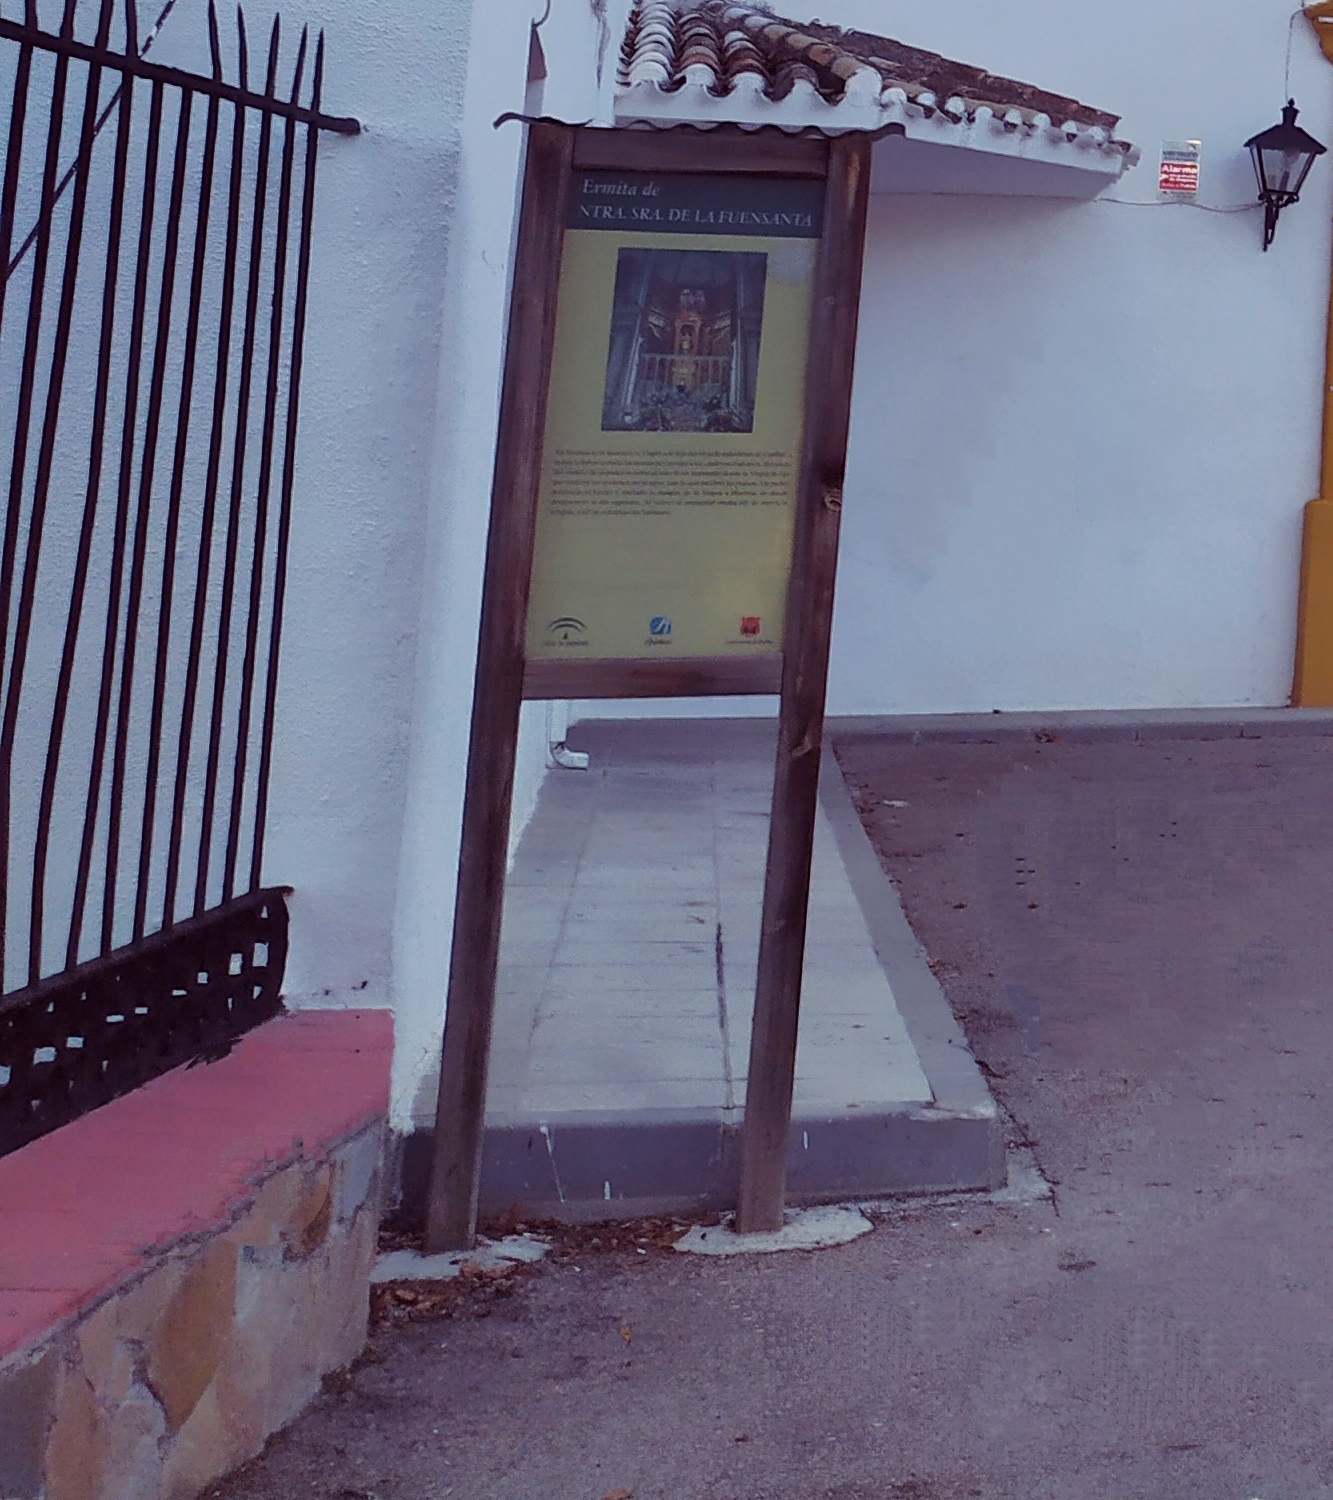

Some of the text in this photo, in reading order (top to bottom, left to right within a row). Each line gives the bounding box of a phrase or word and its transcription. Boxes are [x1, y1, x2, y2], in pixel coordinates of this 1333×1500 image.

[582, 179, 661, 197] Ermita de
[668, 208, 693, 222] DE
[695, 209, 715, 223] LA
[718, 211, 813, 227] FUENSANTA
